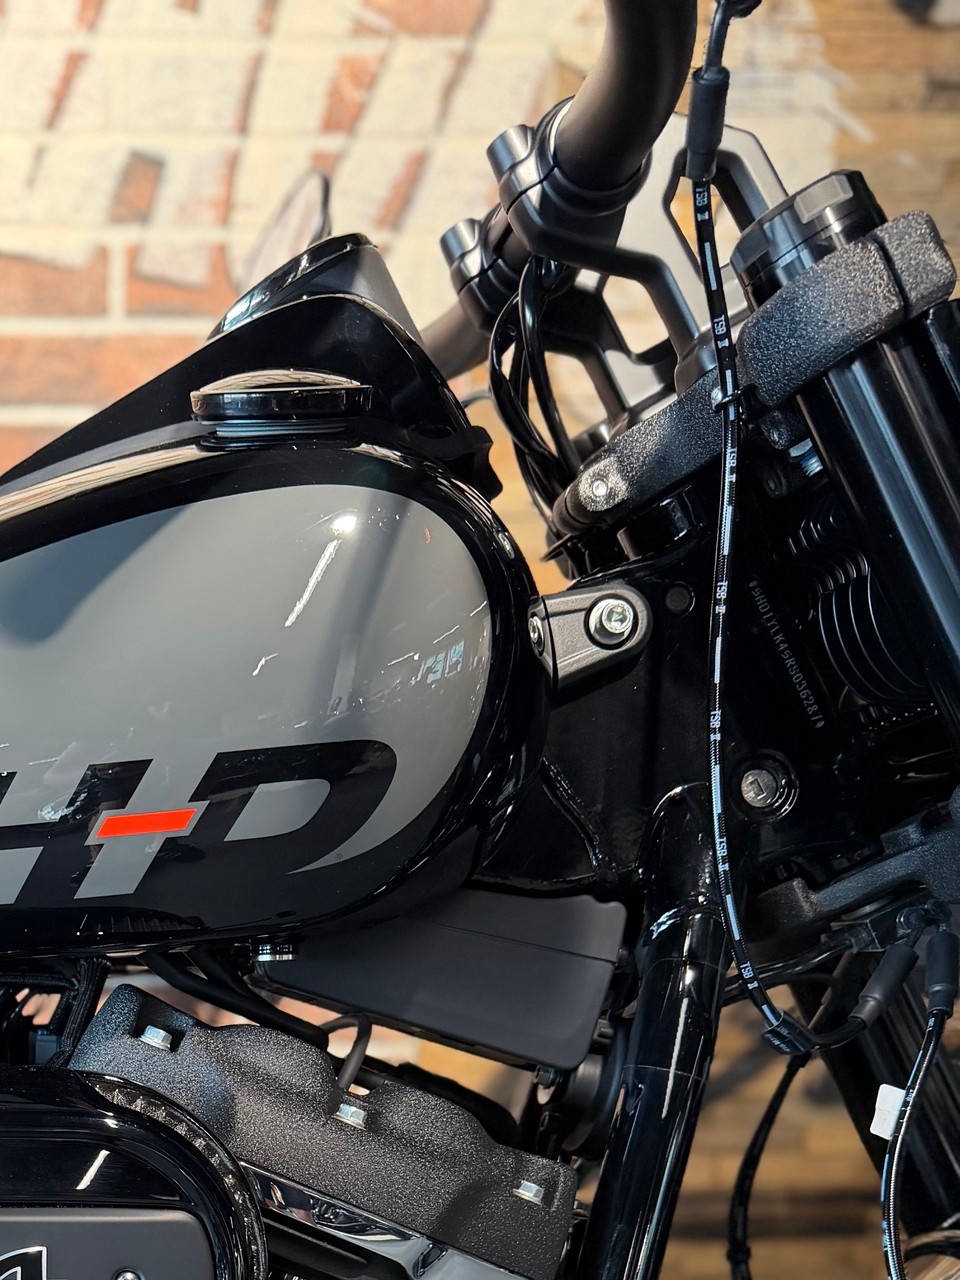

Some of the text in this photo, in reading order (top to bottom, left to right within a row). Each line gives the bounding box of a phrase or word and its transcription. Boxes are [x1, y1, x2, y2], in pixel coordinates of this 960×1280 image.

[713, 315, 726, 335] TSB
[716, 581, 728, 599] TSB
[710, 709, 721, 728] TSB
[740, 961, 754, 979] TSB
